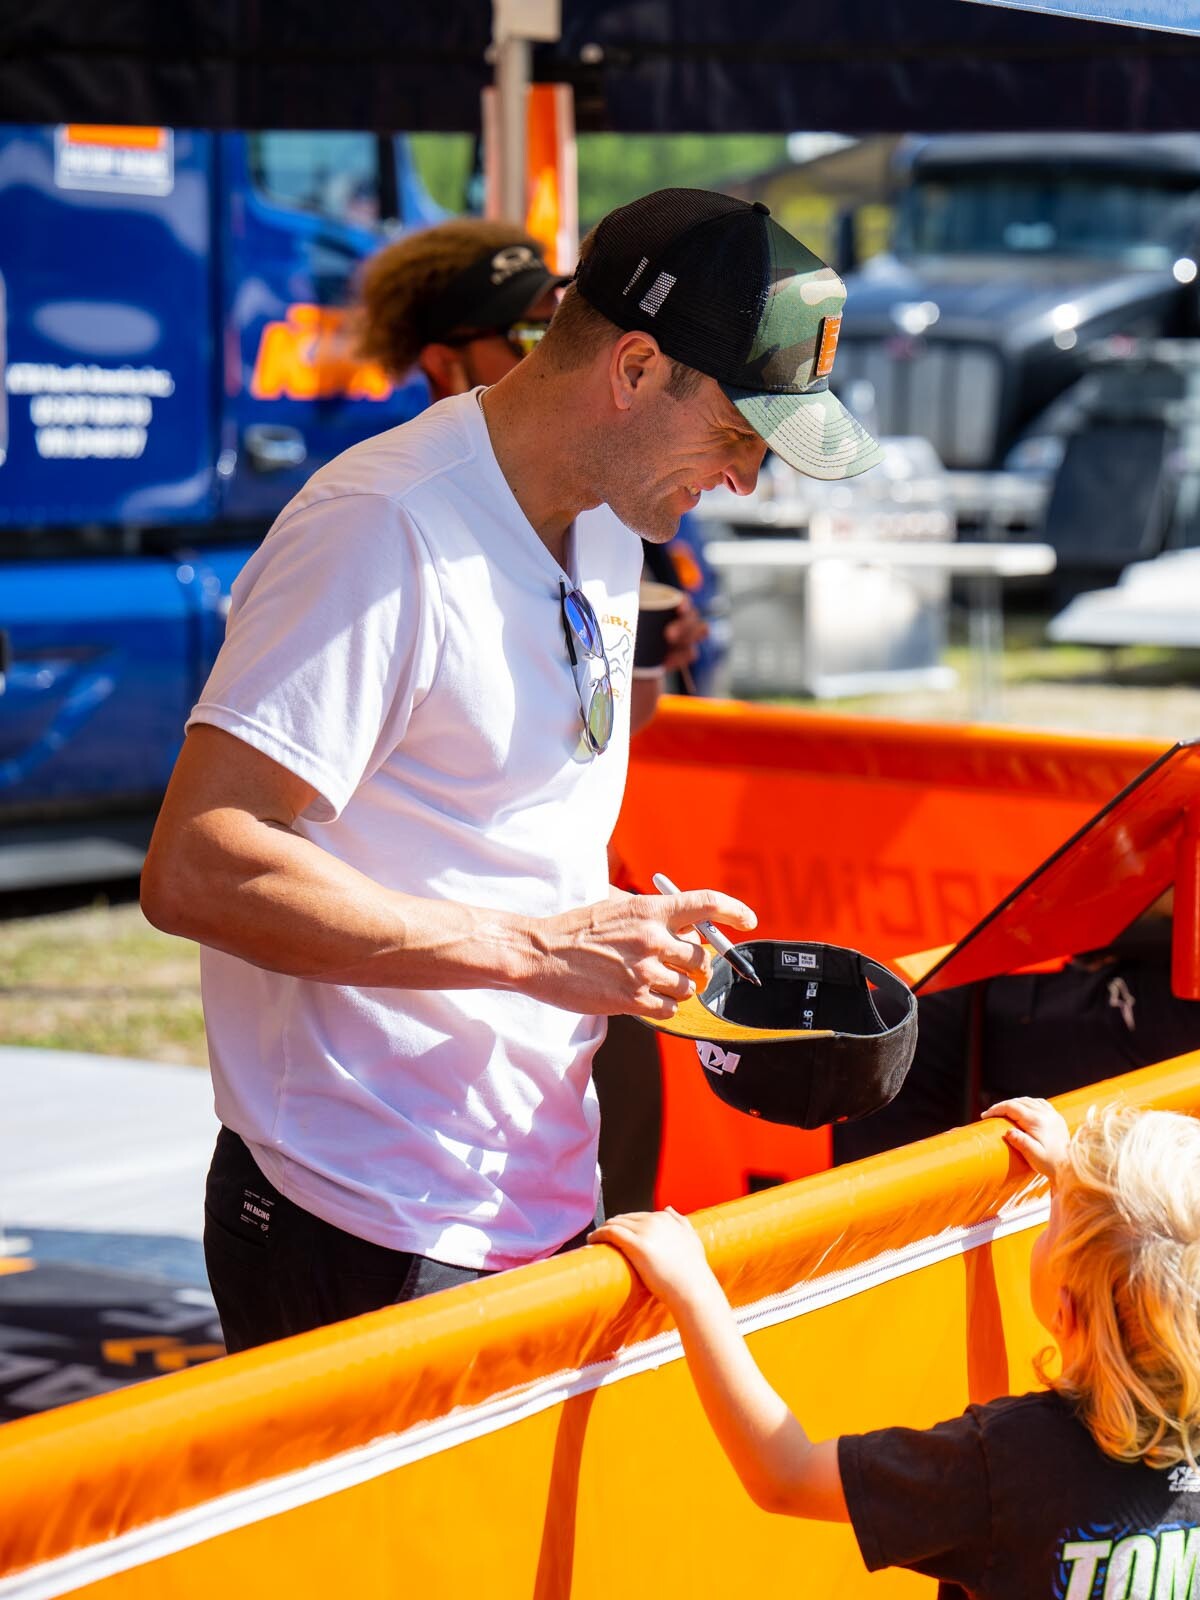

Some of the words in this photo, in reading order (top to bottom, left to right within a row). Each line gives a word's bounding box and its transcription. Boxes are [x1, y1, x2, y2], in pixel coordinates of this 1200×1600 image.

[695, 1040, 741, 1075] KT
[243, 1201, 254, 1212] FOX
[252, 1206, 270, 1221] RACING
